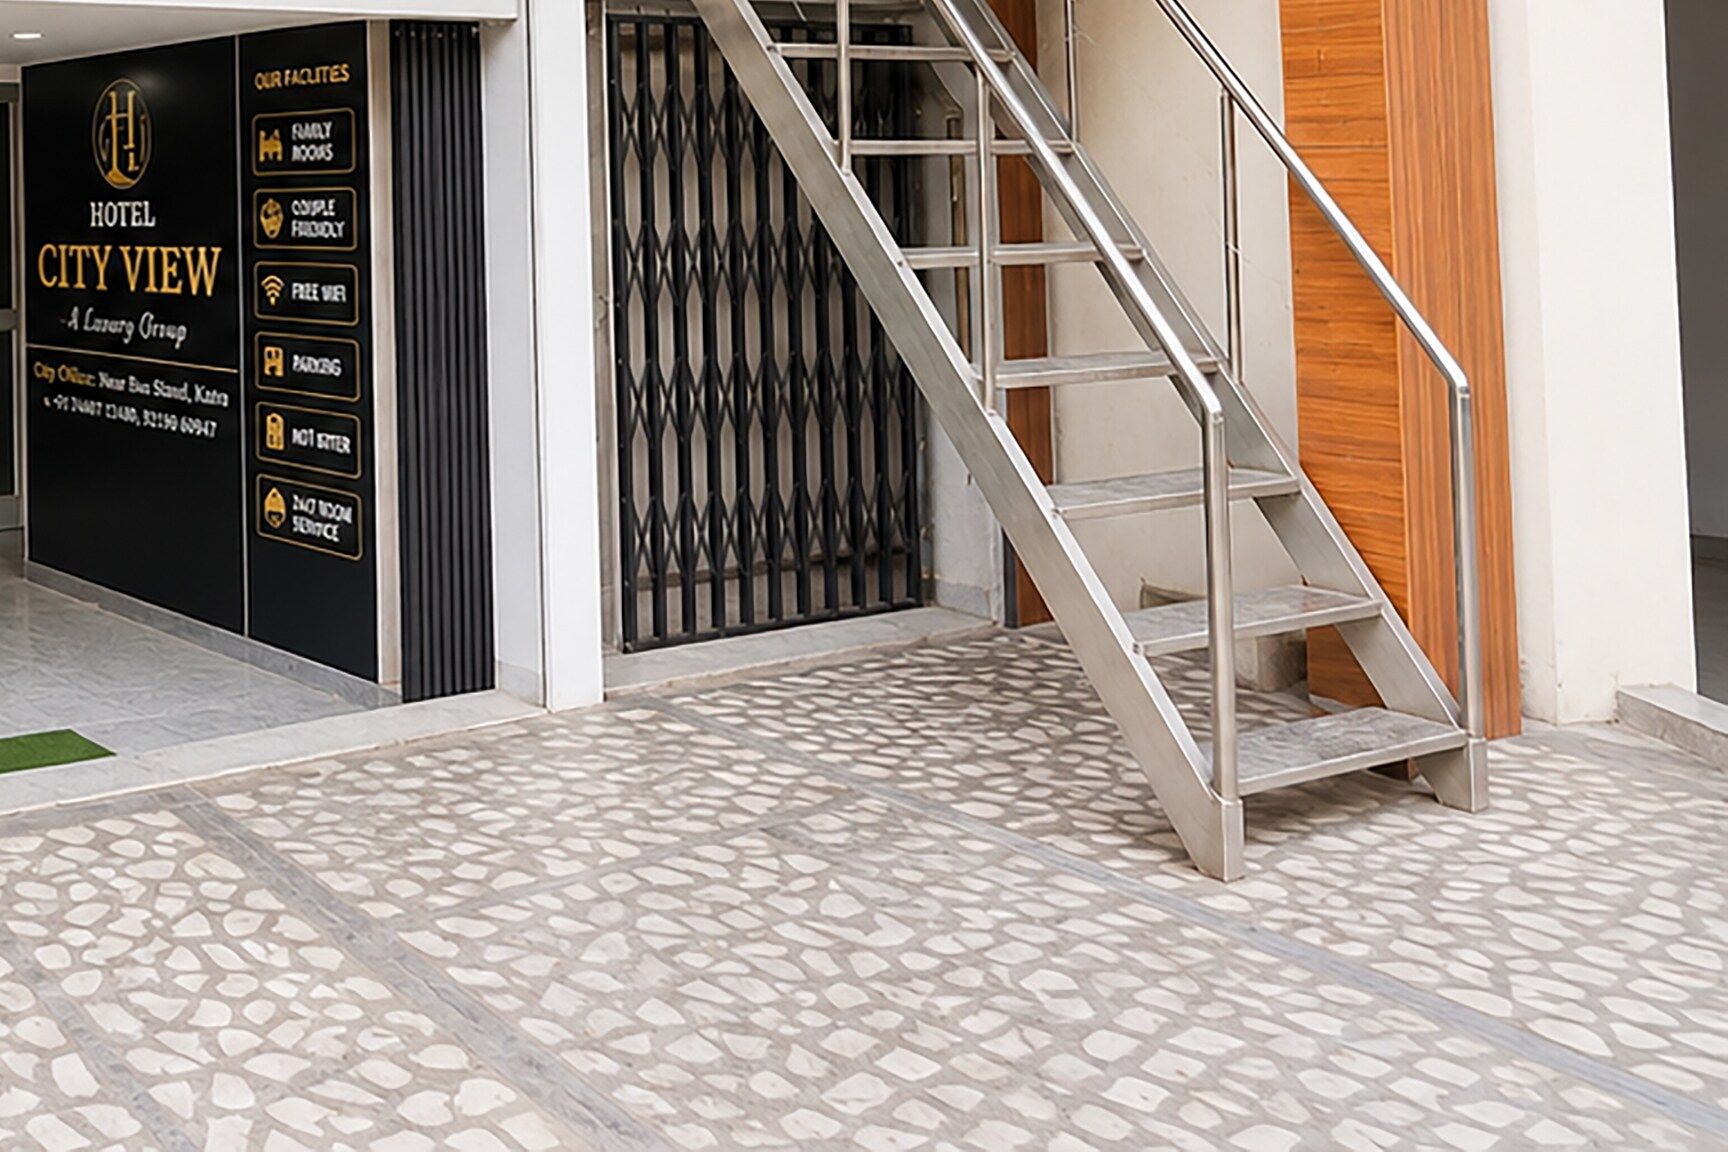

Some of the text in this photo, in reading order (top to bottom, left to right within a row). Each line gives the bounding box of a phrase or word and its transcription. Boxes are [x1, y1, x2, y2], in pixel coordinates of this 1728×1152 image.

[89, 200, 156, 227] HOTEL
[38, 243, 222, 297] CITY VIEW
[67, 305, 79, 331] A
